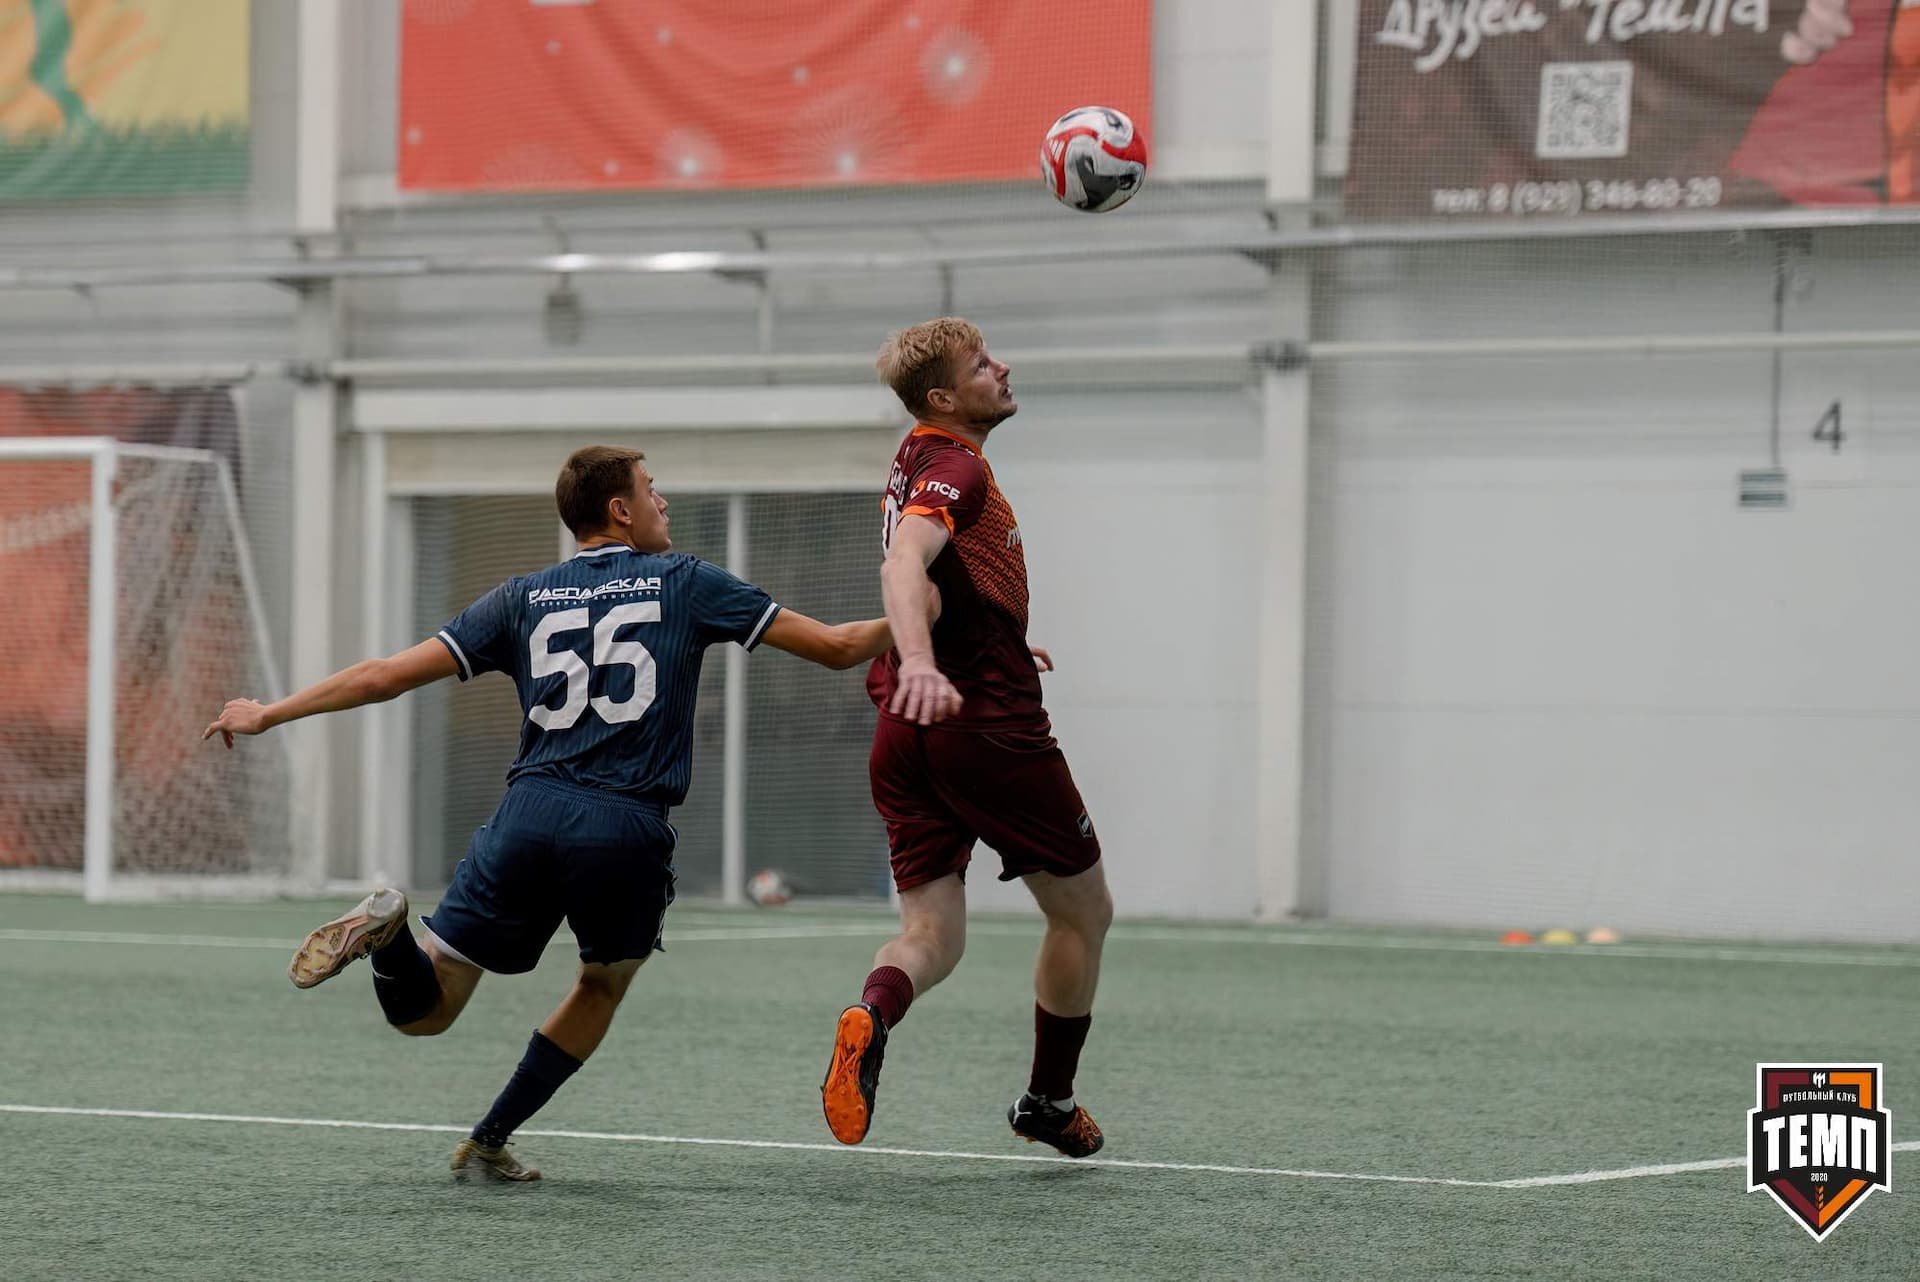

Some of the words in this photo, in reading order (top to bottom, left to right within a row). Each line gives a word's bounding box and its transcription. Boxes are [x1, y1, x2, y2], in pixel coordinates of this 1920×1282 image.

[1487, 181, 1510, 214] 8
[1811, 399, 1847, 453] 4
[926, 480, 961, 501] ПСБ
[528, 600, 661, 732] 55
